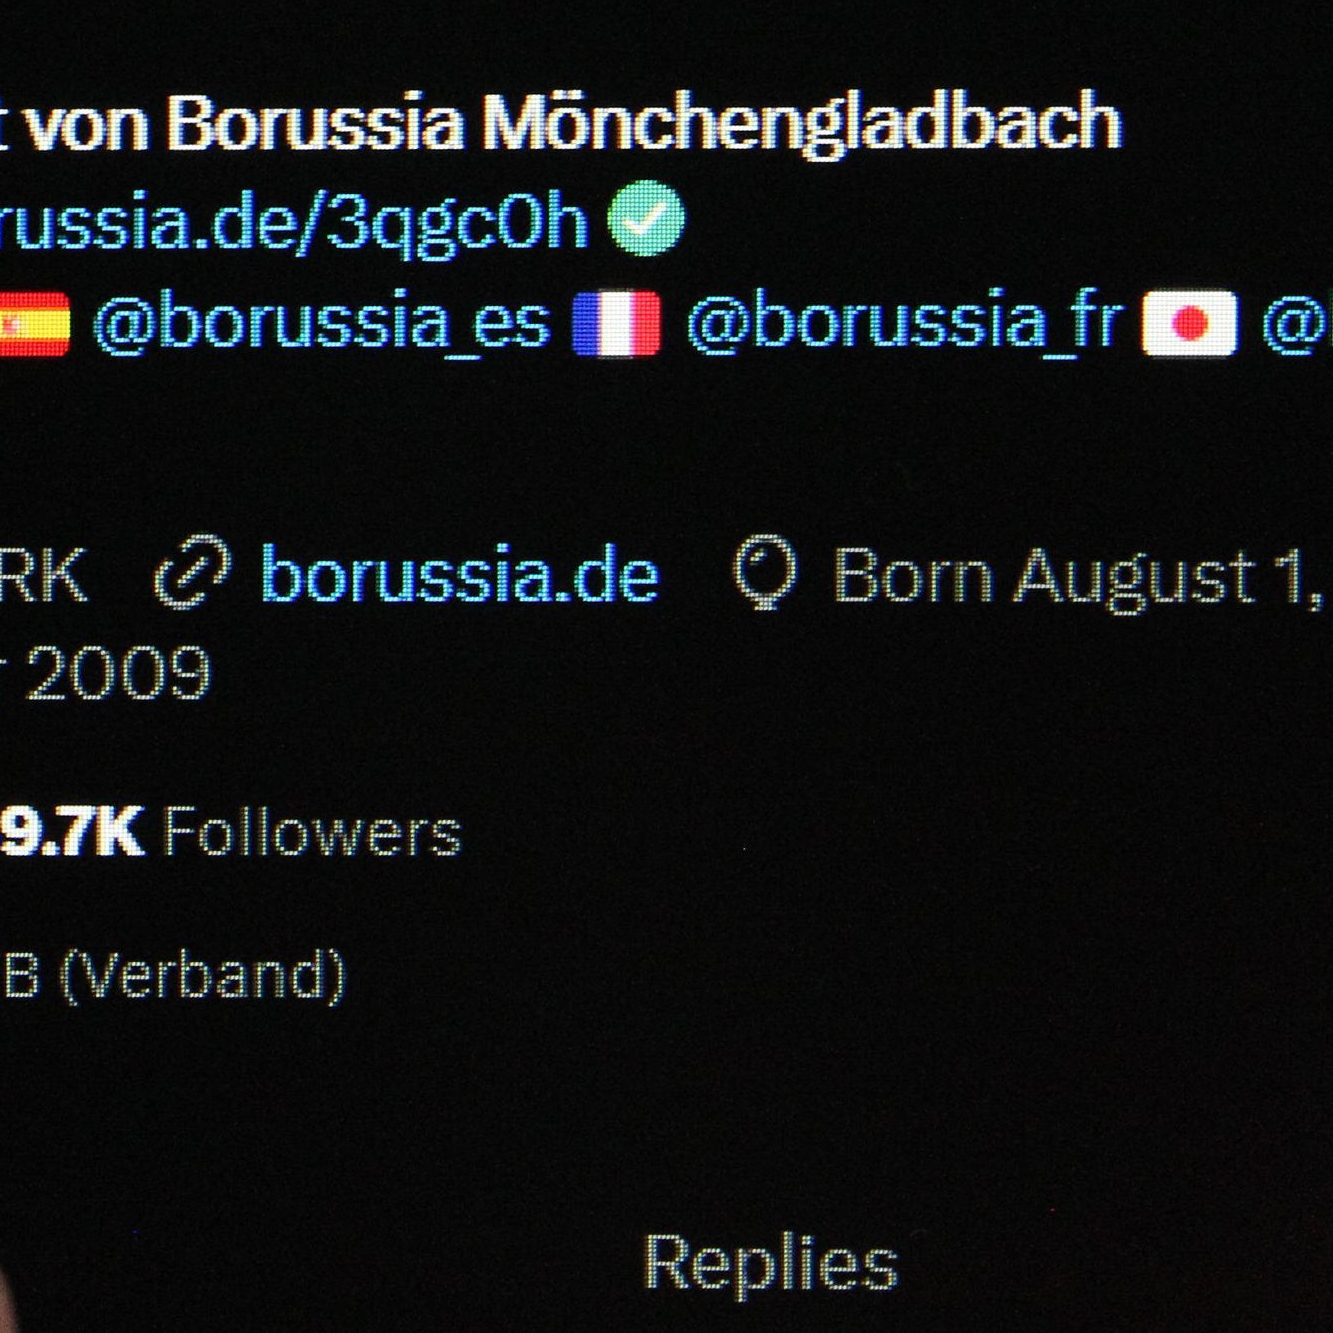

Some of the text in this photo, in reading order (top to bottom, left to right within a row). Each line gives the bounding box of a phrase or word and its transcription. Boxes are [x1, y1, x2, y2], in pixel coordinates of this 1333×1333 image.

[20, 108, 151, 151] von
[167, 89, 468, 151] Borussia
[483, 88, 1124, 163] Mönchengladbach
[93, 287, 552, 361] @borussia_es
[688, 286, 1126, 361] @borussia_fr
[263, 542, 661, 603] borussia.de
[836, 547, 993, 602] Born
[1013, 548, 1256, 616] August
[1276, 549, 1323, 612] 1,
[28, 645, 211, 700] 2009
[166, 806, 460, 856] Followers
[60, 948, 344, 1007] (Verband)
[646, 1231, 898, 1302] Replies
